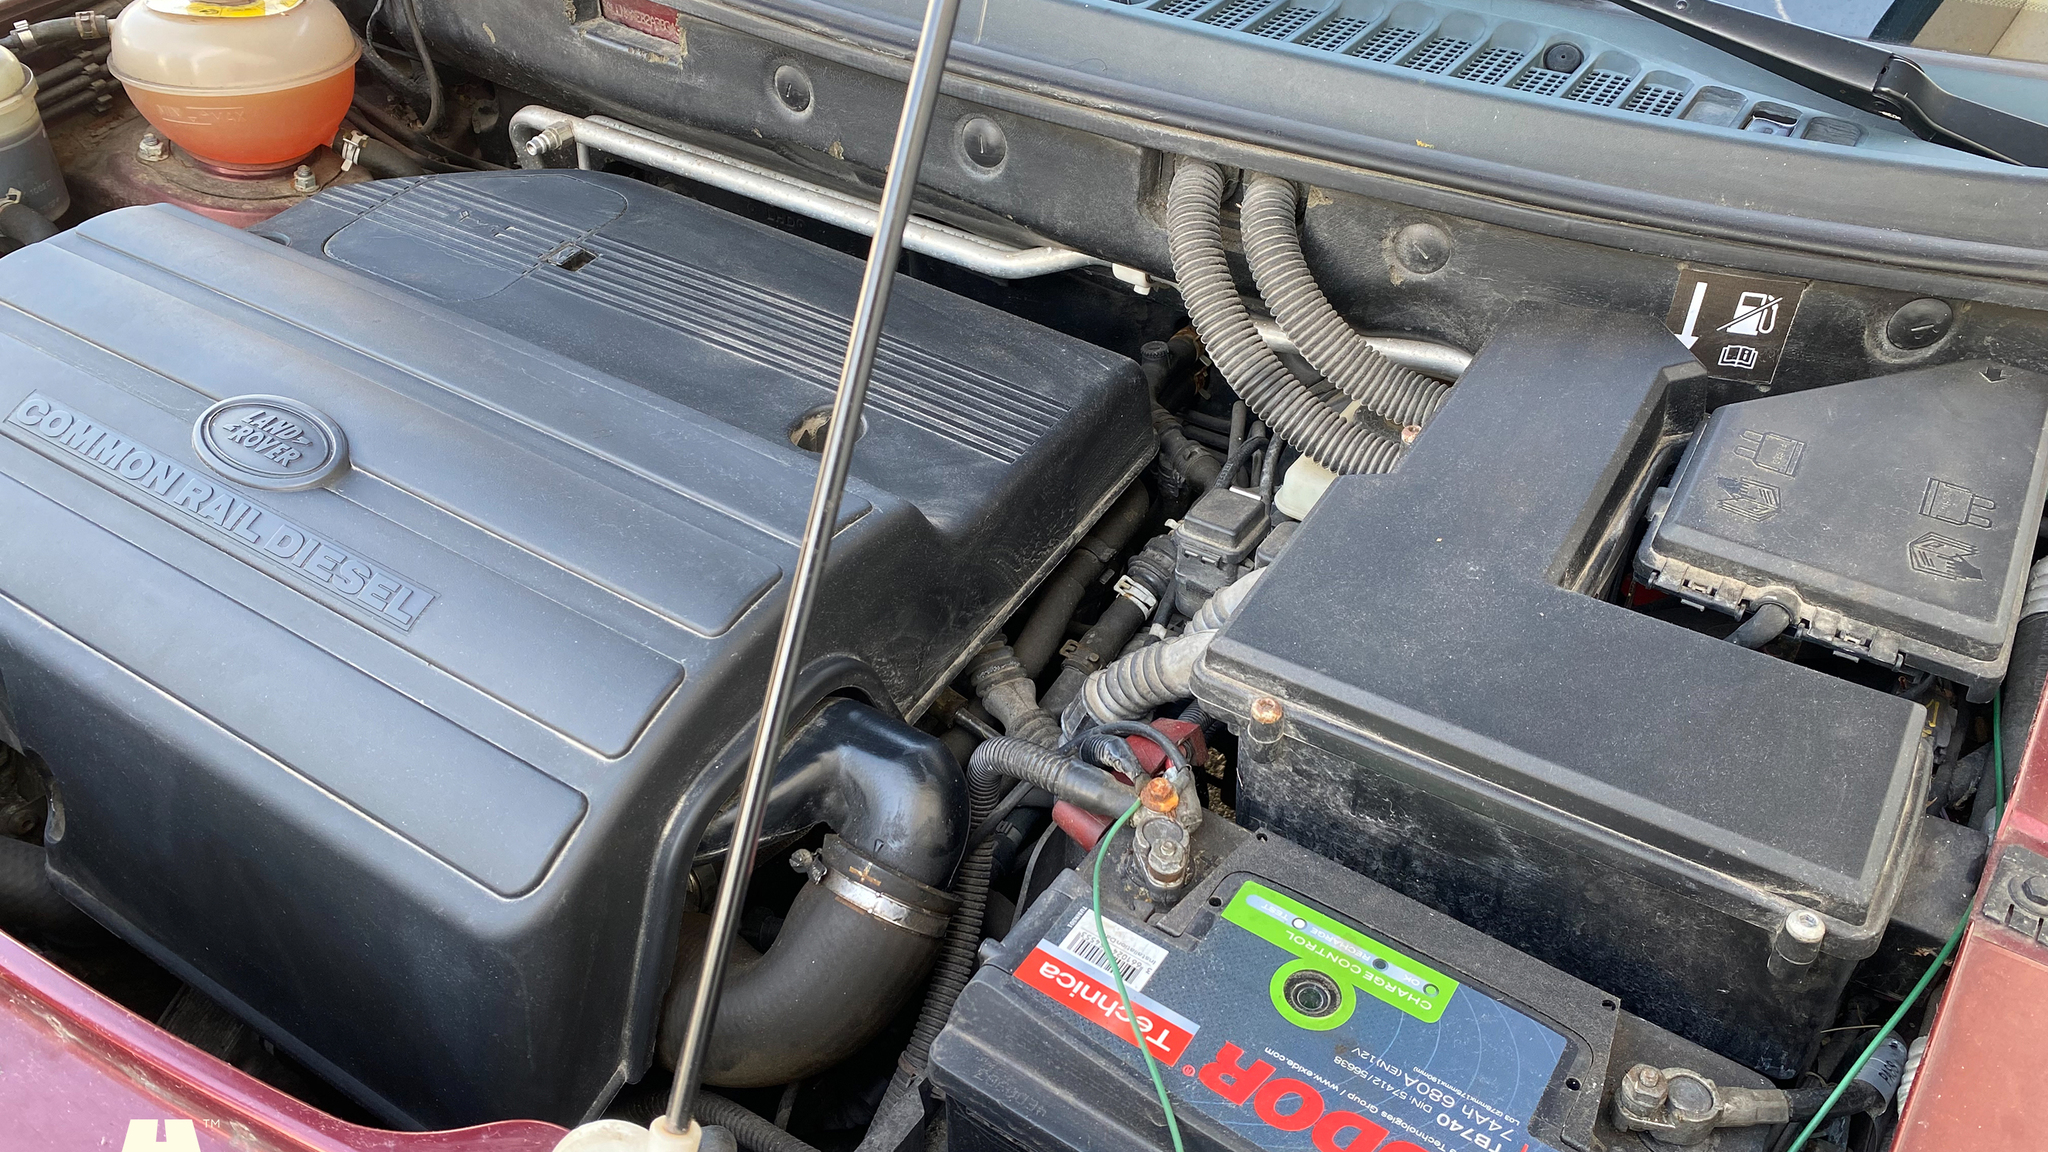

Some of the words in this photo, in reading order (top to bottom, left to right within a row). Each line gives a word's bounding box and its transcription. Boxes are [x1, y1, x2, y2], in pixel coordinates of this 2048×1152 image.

[228, 424, 302, 468] ROVER
[240, 410, 306, 445] LAND
[15, 393, 184, 496] COMMON
[173, 476, 262, 545] RAIL
[264, 524, 436, 625] DIESEL
[1261, 902, 1289, 921] TEST
[1118, 940, 1157, 966] Installation
[1285, 929, 1362, 975] CONTROL
[1310, 927, 1371, 963] RECHARGE
[1145, 967, 1153, 975] 3
[1403, 973, 1420, 987] OK
[1038, 960, 1171, 1053] Technica
[1362, 969, 1433, 1011] CHARGE
[1264, 1046, 1340, 1092] www.exide.com
[1347, 1092, 1379, 1114] Group
[1404, 1072, 1456, 1109] 680A
[1409, 1095, 1433, 1114] DIN:
[1380, 1110, 1446, 1151] Technologies
[1436, 1113, 1503, 1152] TB740
[1461, 1104, 1515, 1142] 74Ah
